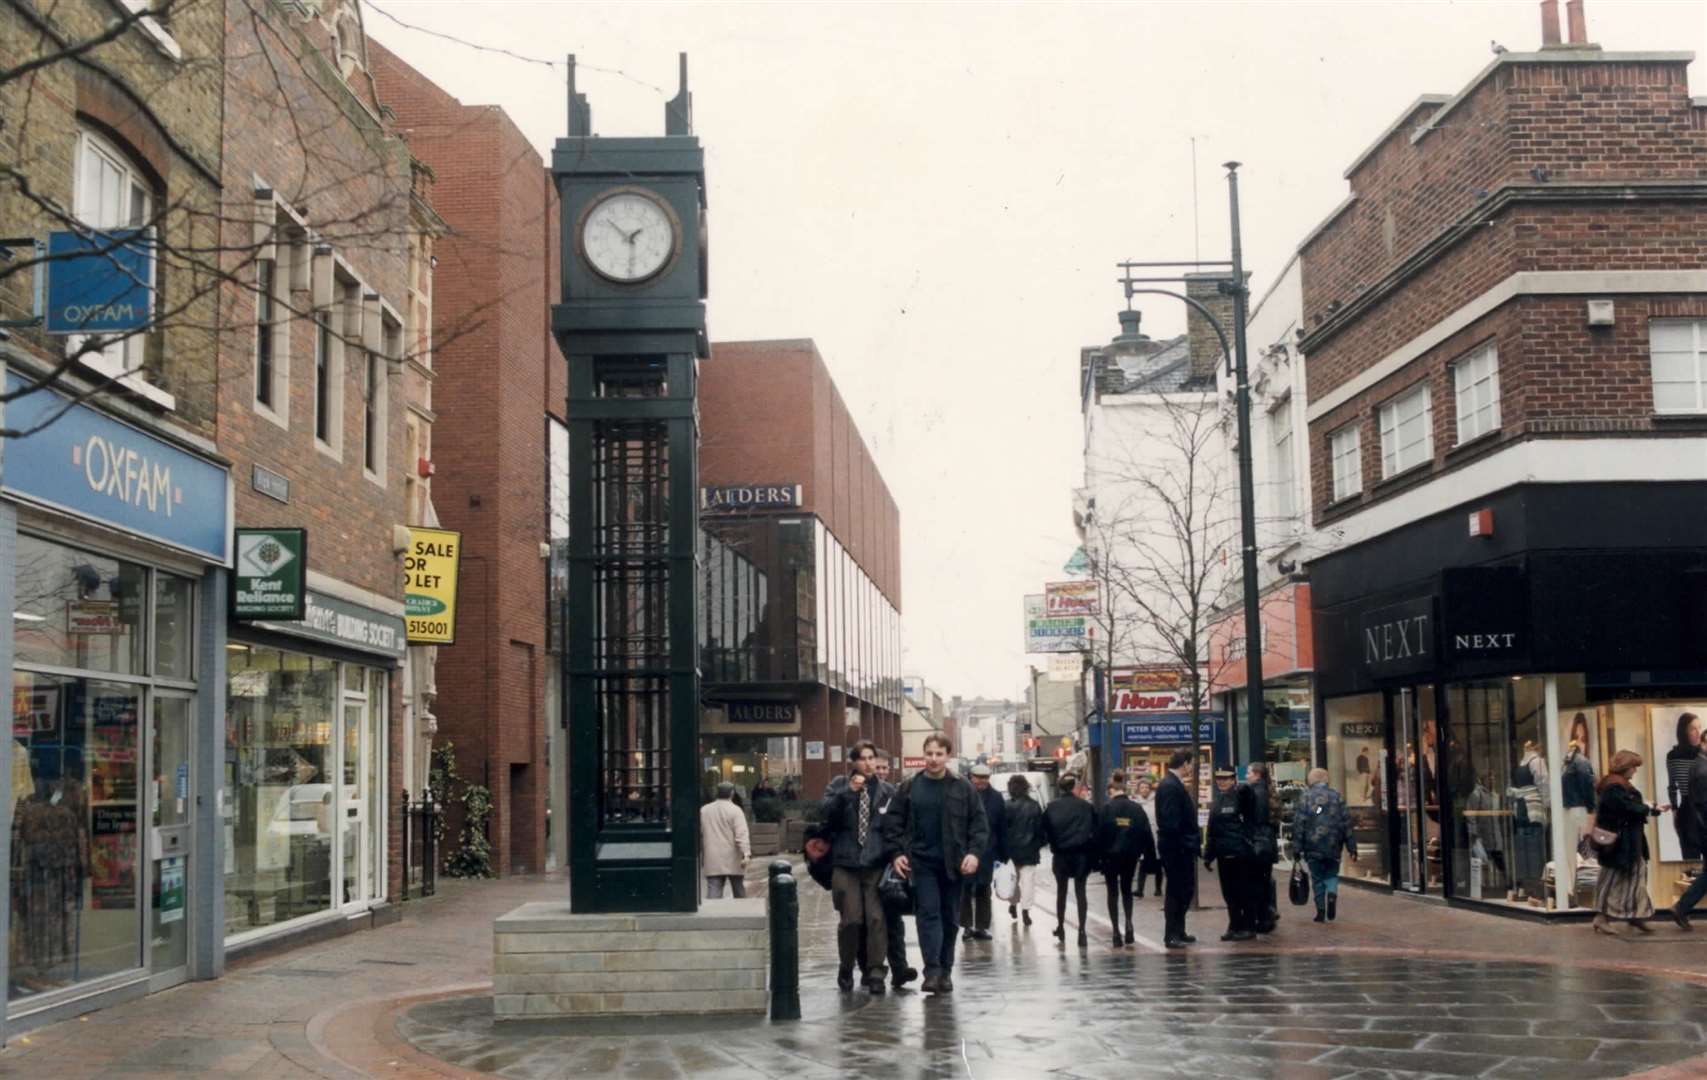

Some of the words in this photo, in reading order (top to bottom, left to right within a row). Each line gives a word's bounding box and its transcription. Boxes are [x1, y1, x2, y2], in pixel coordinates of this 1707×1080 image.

[64, 304, 134, 322] OXFAM
[86, 436, 171, 517] OXFAM
[415, 542, 454, 557] SALE
[251, 579, 282, 591] Kent
[416, 574, 441, 588] LET
[237, 589, 295, 604] Reliance
[337, 614, 369, 643] BUILDING
[369, 622, 396, 649] SOCIETY
[409, 621, 448, 635] 515001
[1365, 615, 1428, 665] NEXT
[1456, 633, 1516, 649] NEXT
[1120, 693, 1176, 709] Hour
[1127, 725, 1149, 733] PETER
